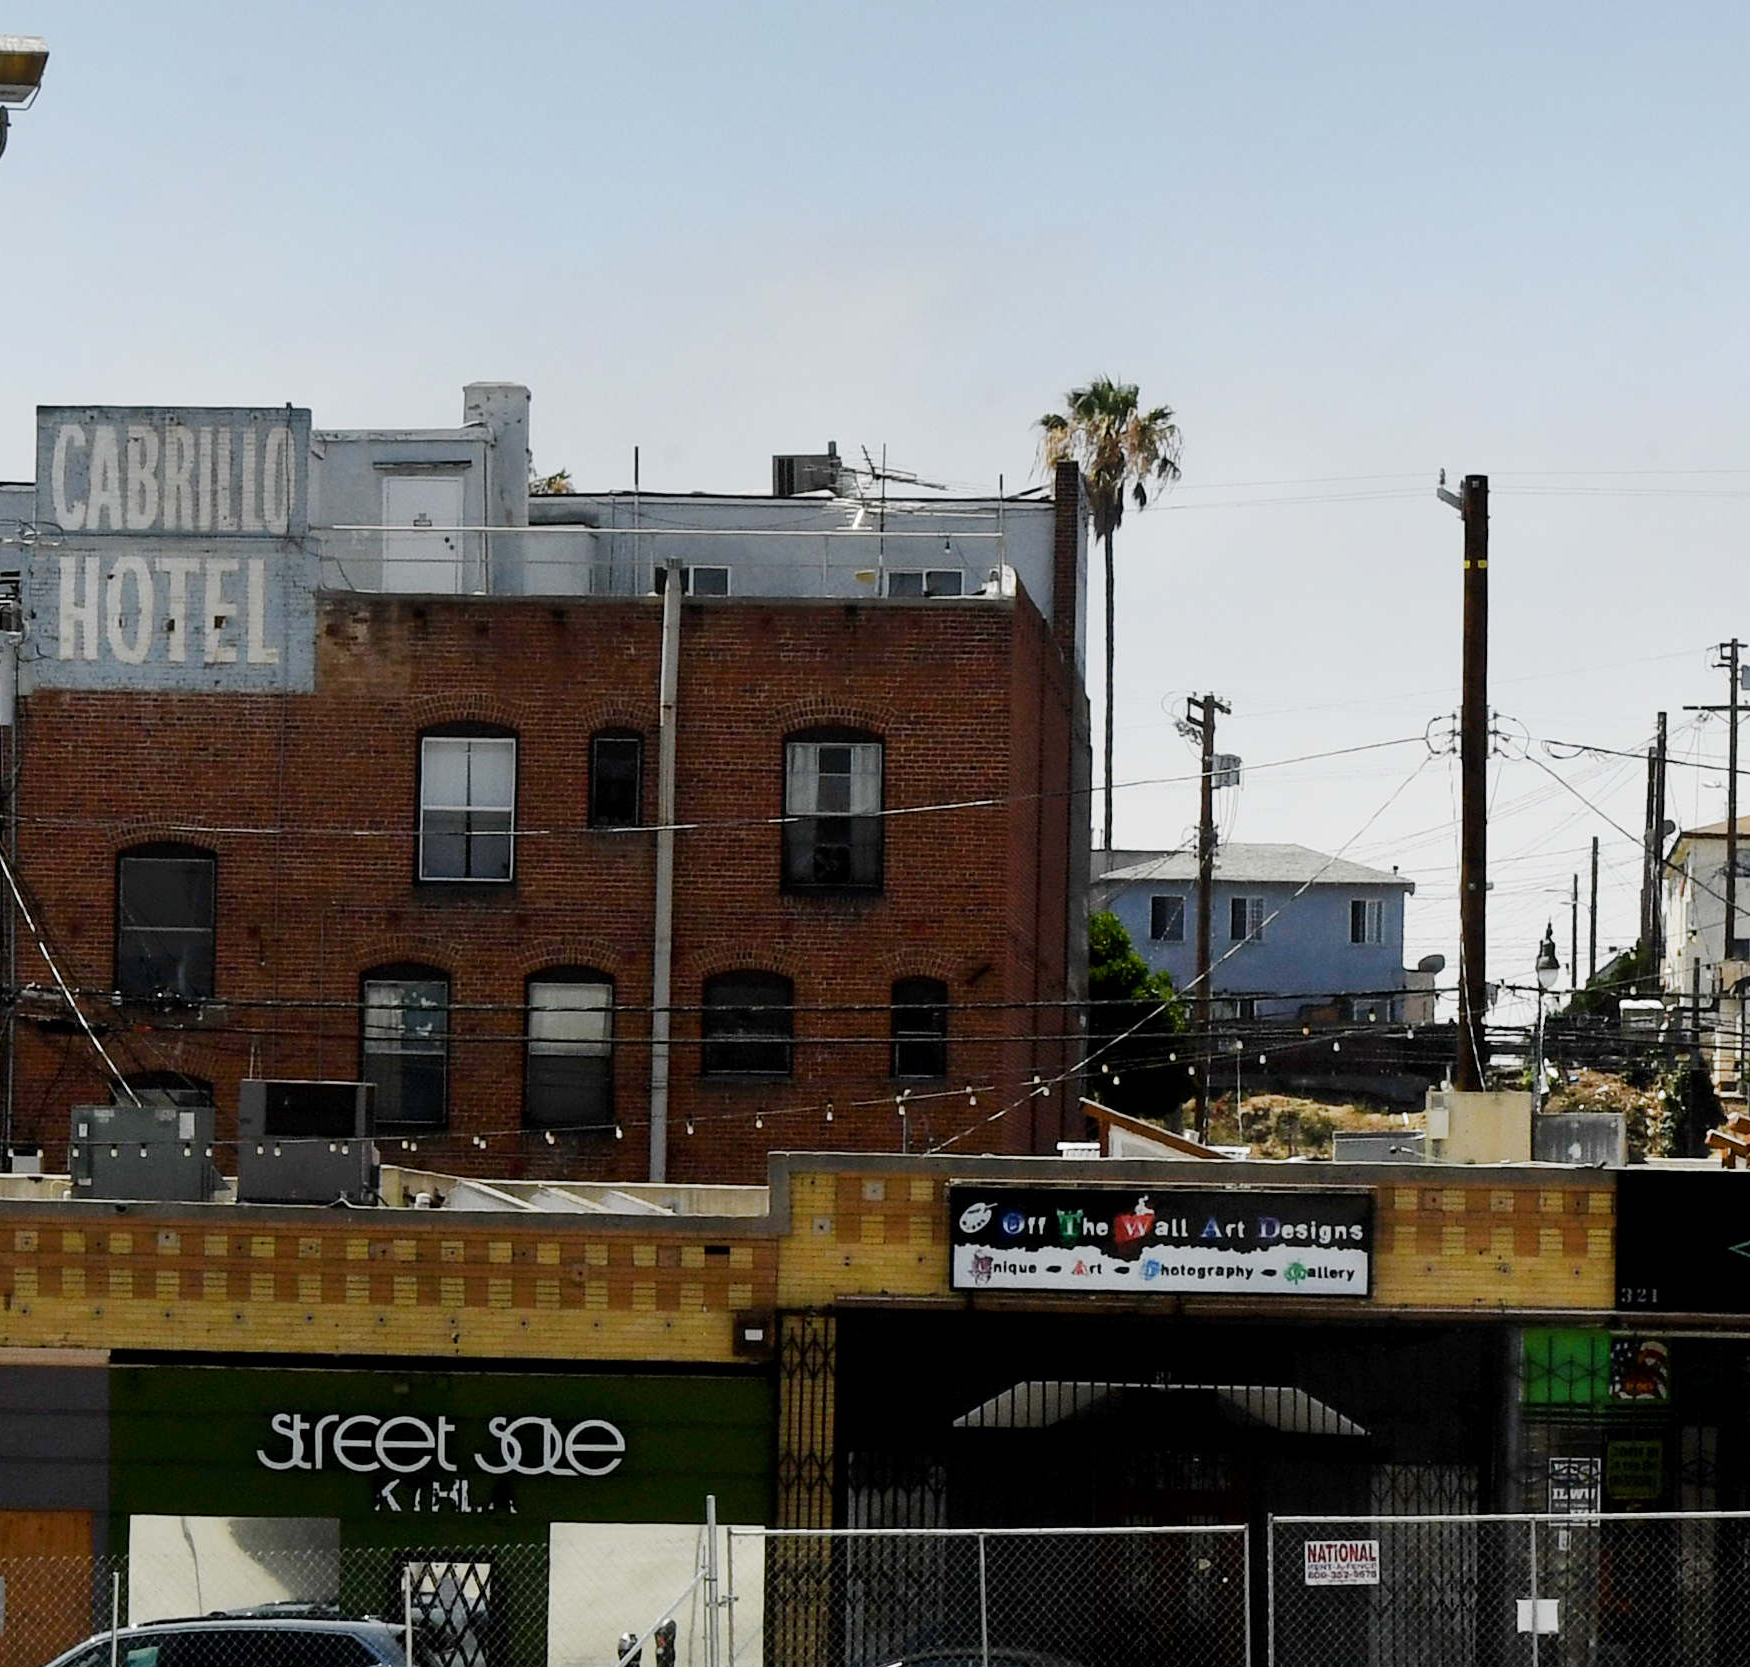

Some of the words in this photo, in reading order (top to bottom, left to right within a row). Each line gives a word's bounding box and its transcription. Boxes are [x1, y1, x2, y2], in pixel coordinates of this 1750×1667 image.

[51, 424, 296, 535] CABRILLO
[58, 555, 280, 664] HOTEL
[1002, 1212, 1047, 1236] Off
[1058, 1209, 1109, 1237] The
[1120, 1214, 1189, 1239] Wall
[1201, 1215, 1246, 1238] Art
[1258, 1216, 1364, 1244] Designs
[1071, 1259, 1102, 1275] Art
[1142, 1258, 1254, 1281] Photography
[1286, 1259, 1355, 1281] Gallery
[1621, 1287, 1659, 1304] 321
[1307, 1543, 1377, 1563] NATIONAL
